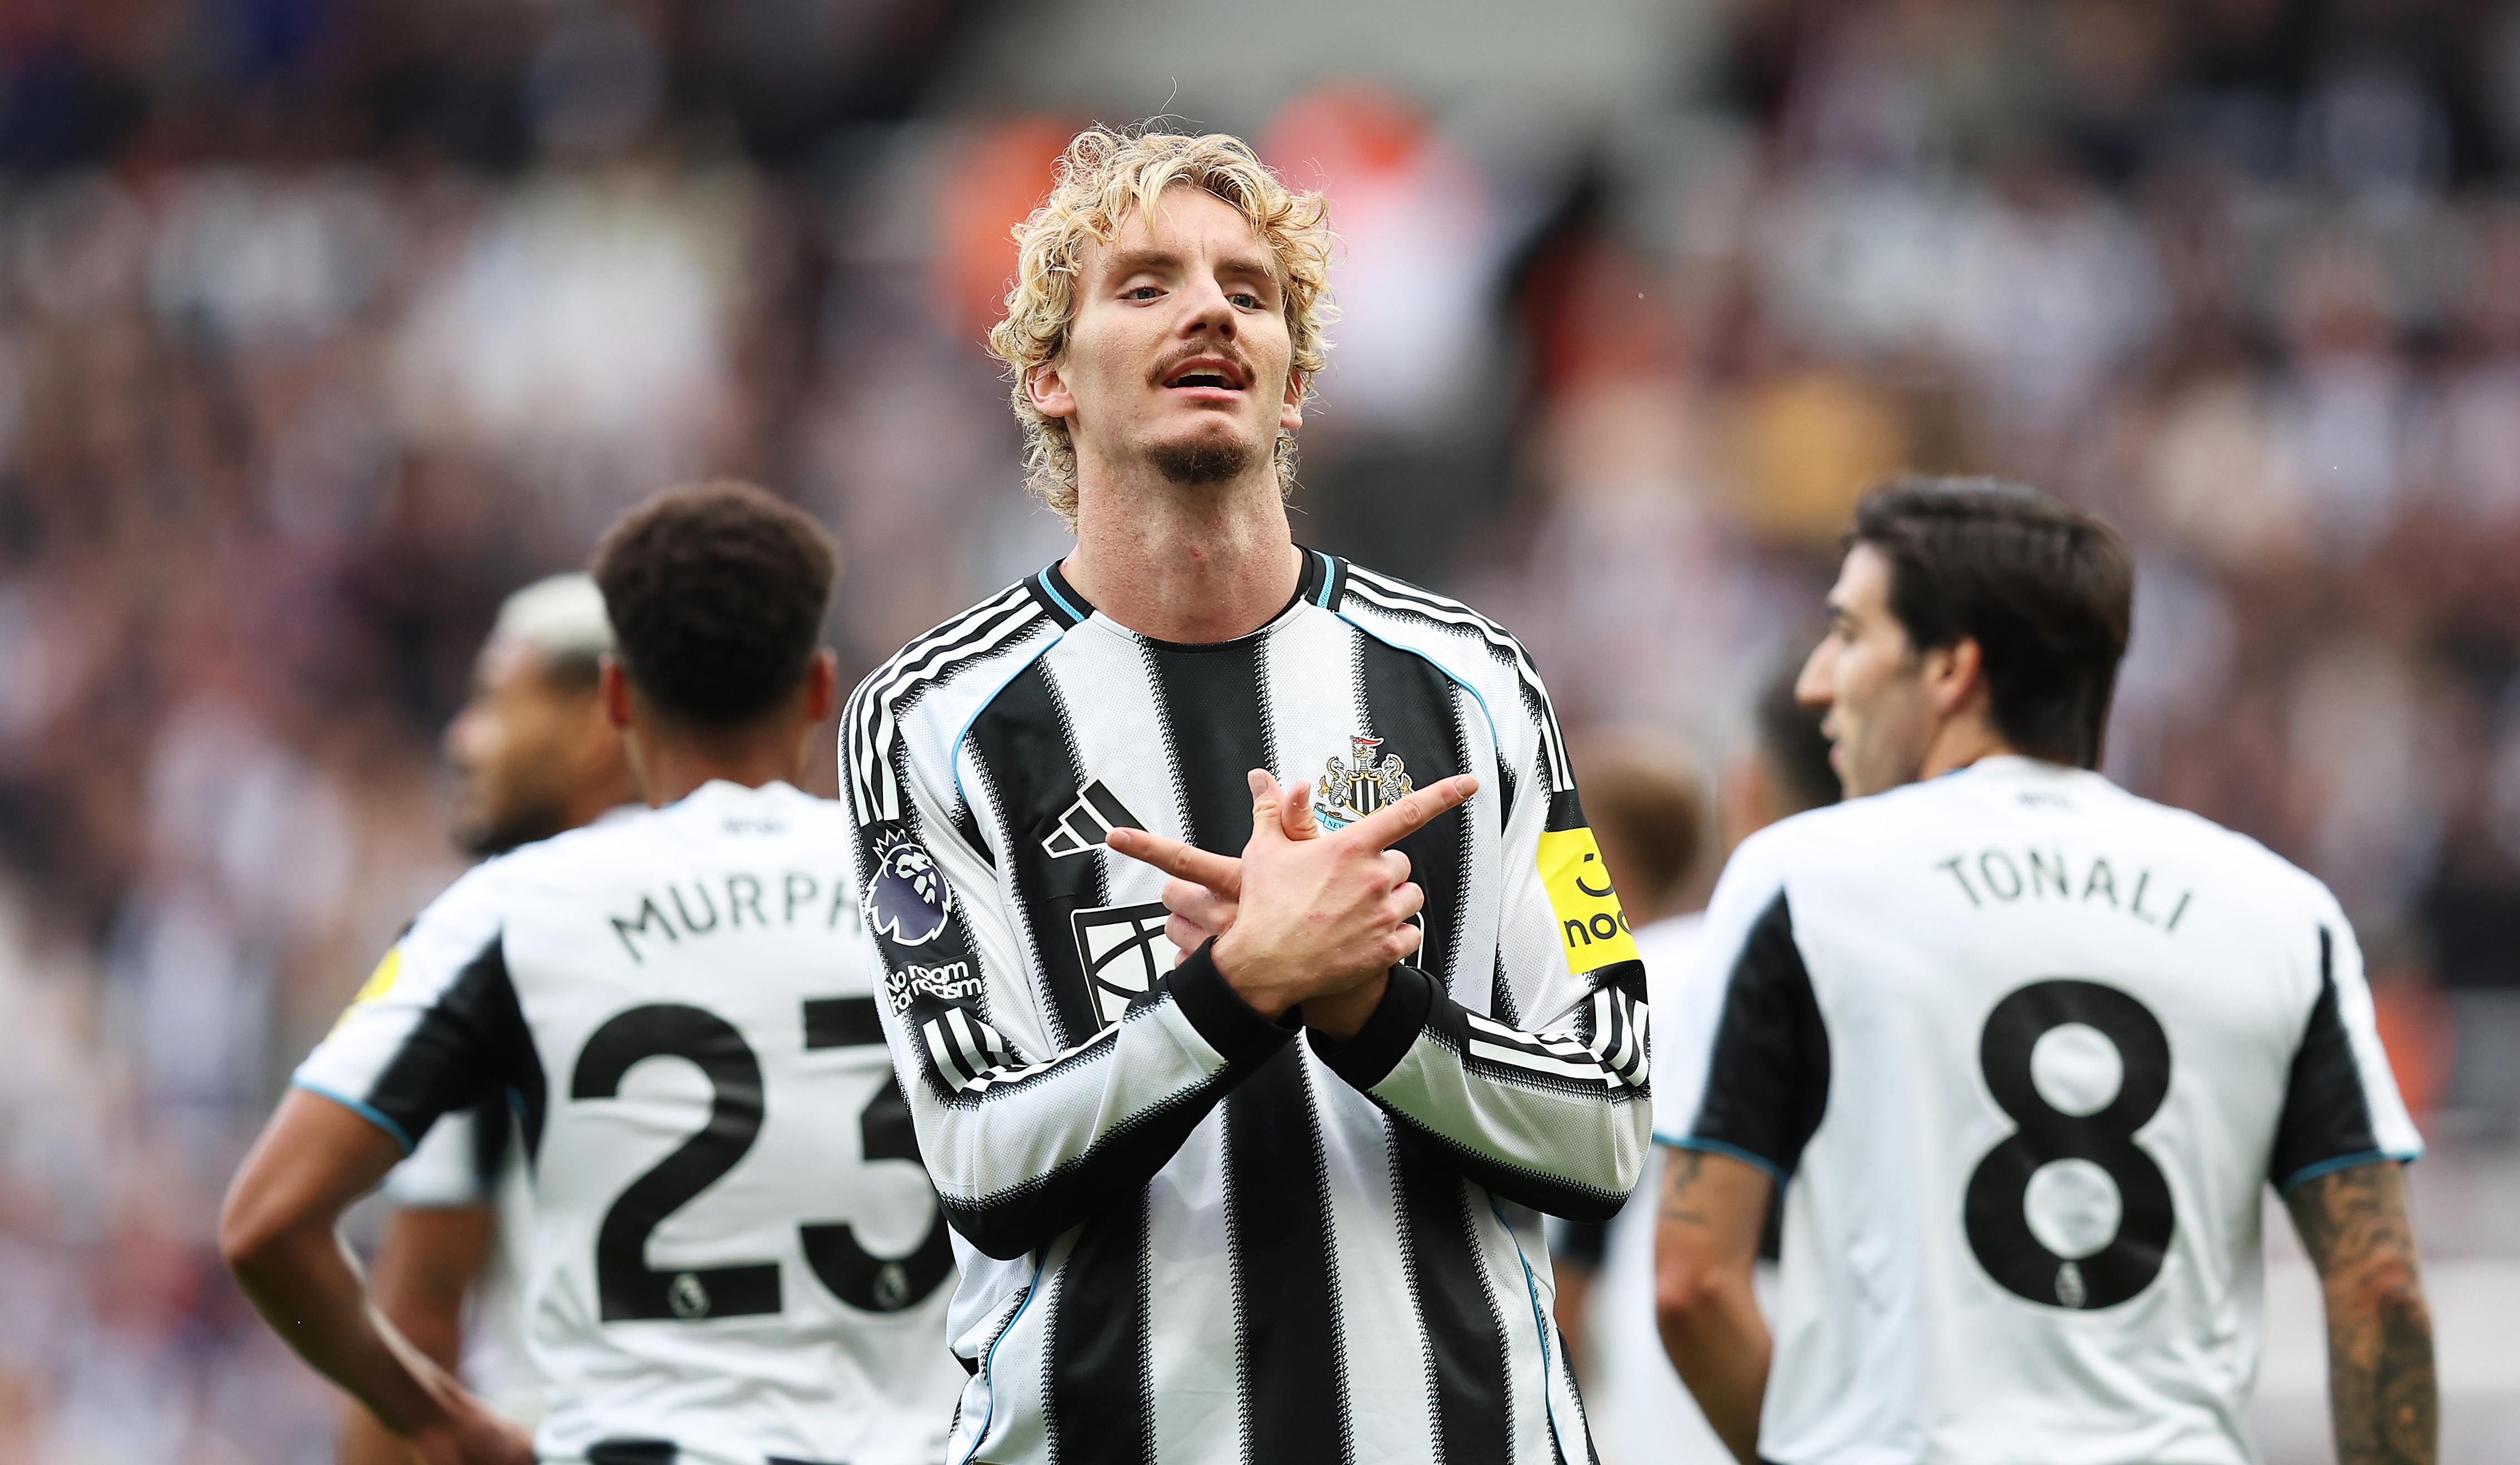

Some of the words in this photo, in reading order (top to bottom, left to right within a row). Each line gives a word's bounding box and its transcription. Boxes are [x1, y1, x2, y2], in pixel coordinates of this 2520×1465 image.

[1934, 849, 2191, 933] TONALI
[884, 970, 906, 1000] No
[907, 961, 969, 984] room
[911, 978, 983, 999] racism
[571, 994, 955, 1321] 23
[1962, 977, 2174, 1310] 8
